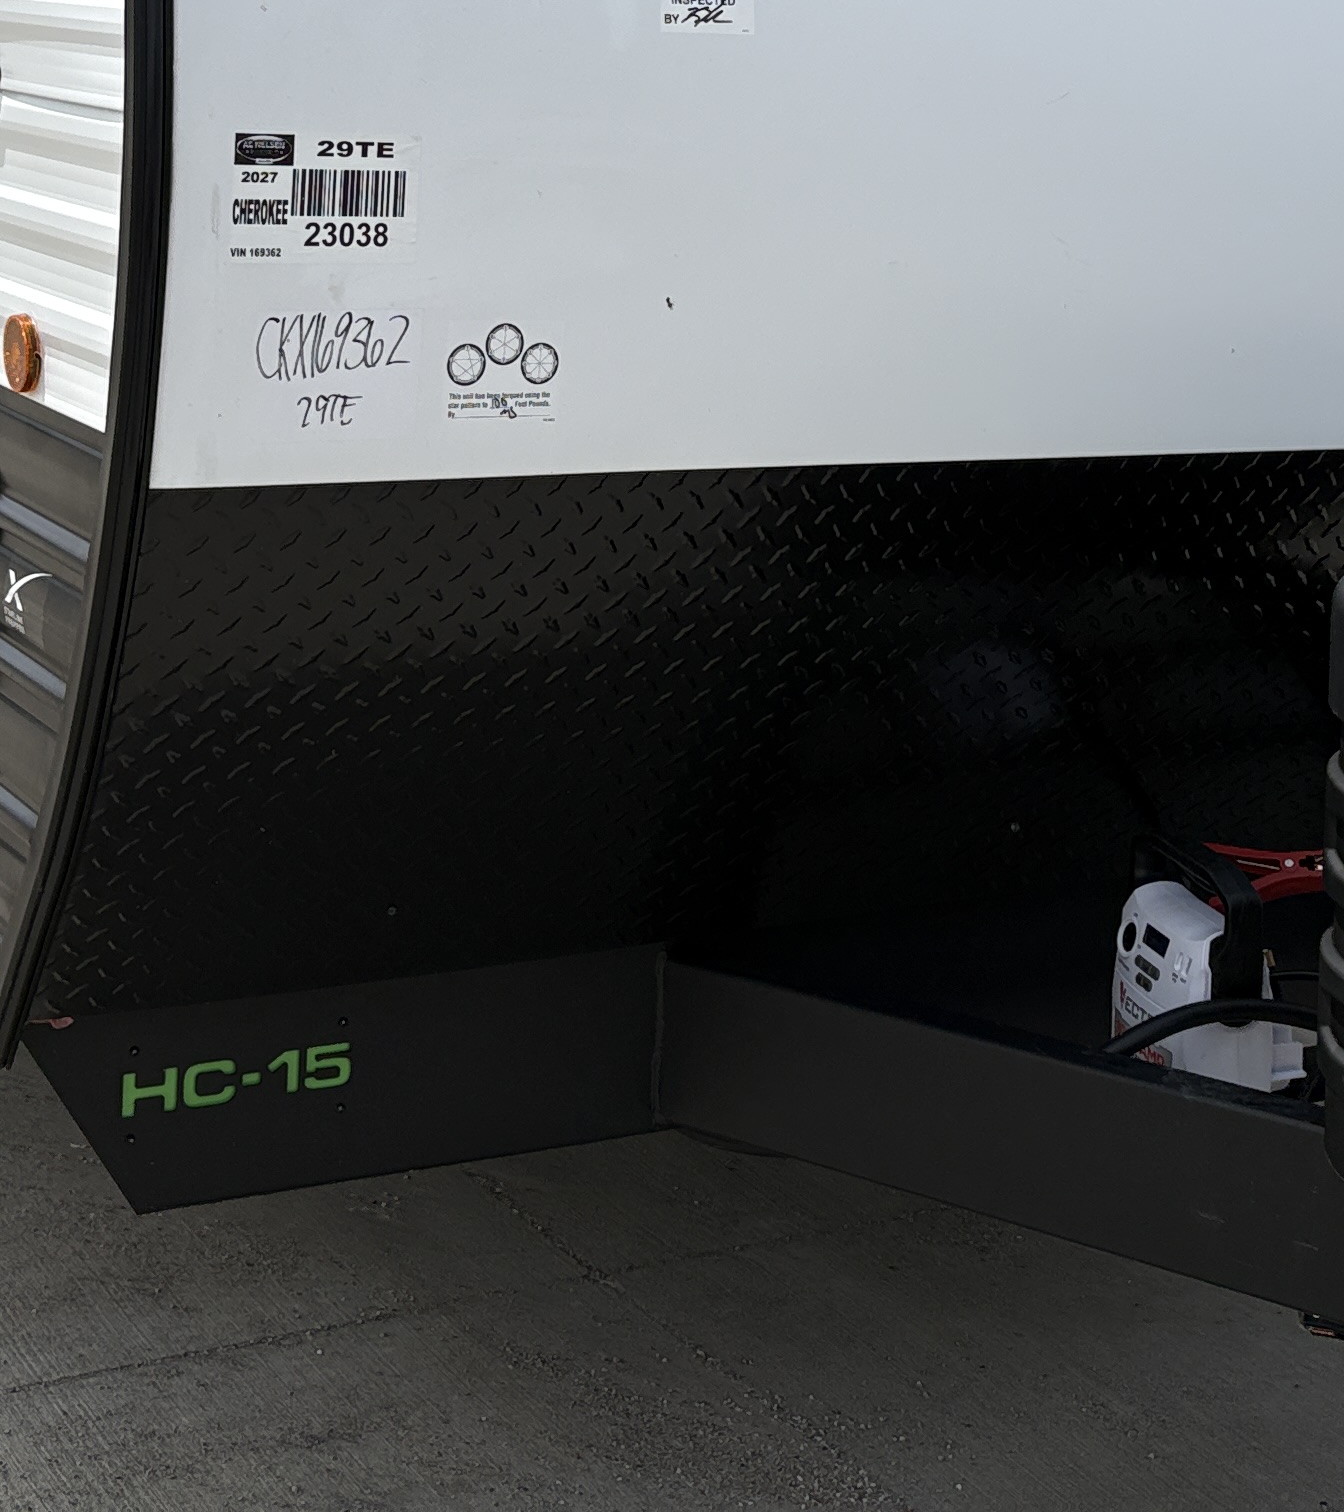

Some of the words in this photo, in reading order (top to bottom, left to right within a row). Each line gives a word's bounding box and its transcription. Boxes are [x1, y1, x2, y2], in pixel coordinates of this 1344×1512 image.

[664, 14, 679, 24] BY
[316, 140, 395, 159] 29TE
[241, 171, 278, 183] 2027
[232, 198, 289, 225] CHEROKEE
[303, 222, 389, 247] 23038
[230, 248, 246, 257] VIN
[250, 248, 282, 257] 169362
[121, 1042, 352, 1118] HC-15
